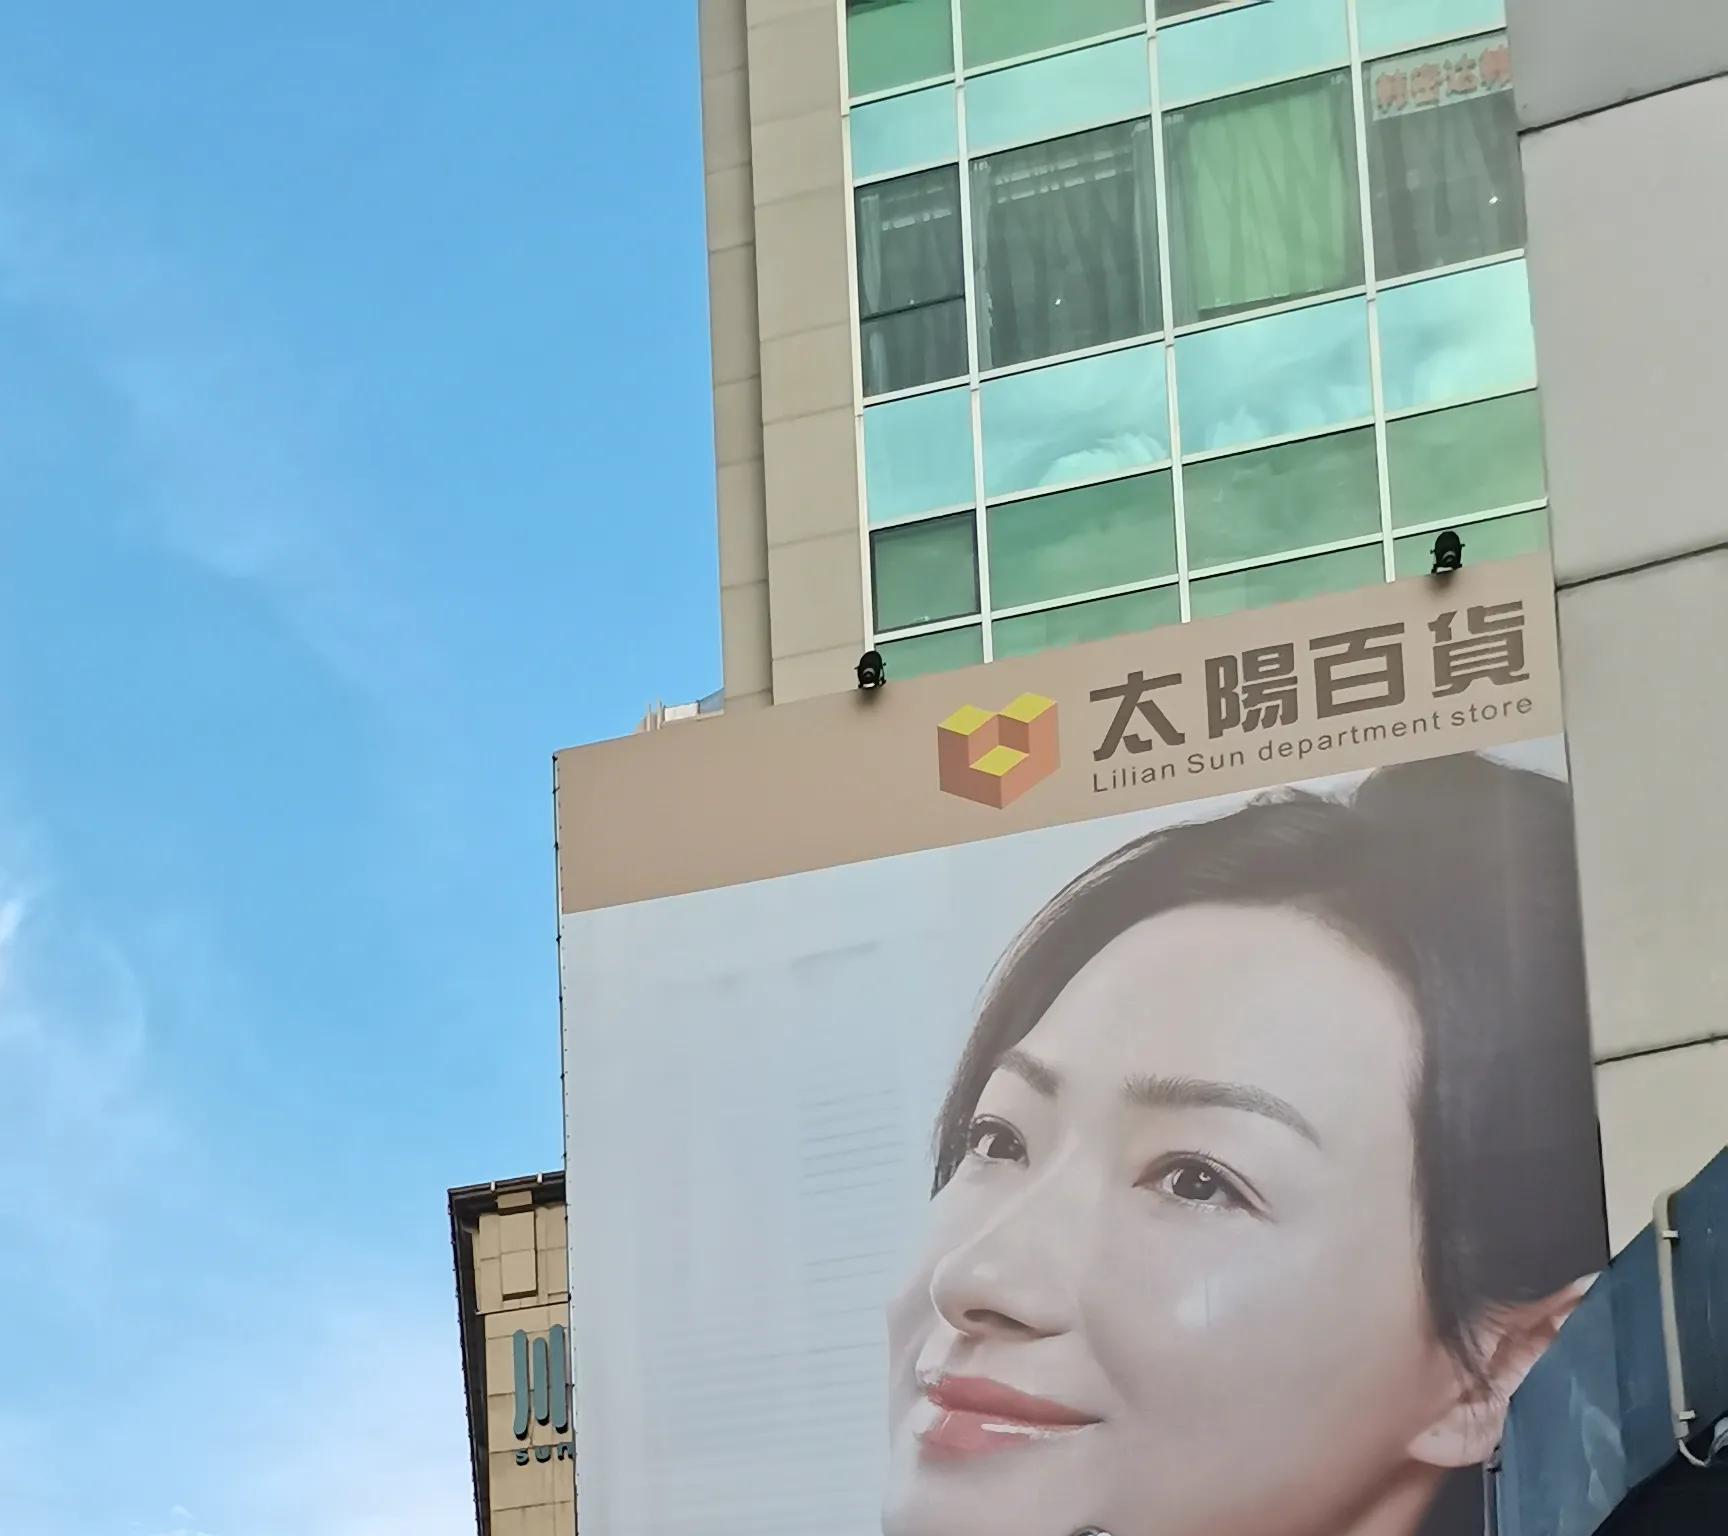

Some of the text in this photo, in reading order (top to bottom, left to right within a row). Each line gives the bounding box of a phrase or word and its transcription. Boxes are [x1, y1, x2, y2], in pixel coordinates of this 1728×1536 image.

[1089, 600, 1530, 762] 太陽百貨
[1092, 693, 1534, 793] Lilian Sun department store
